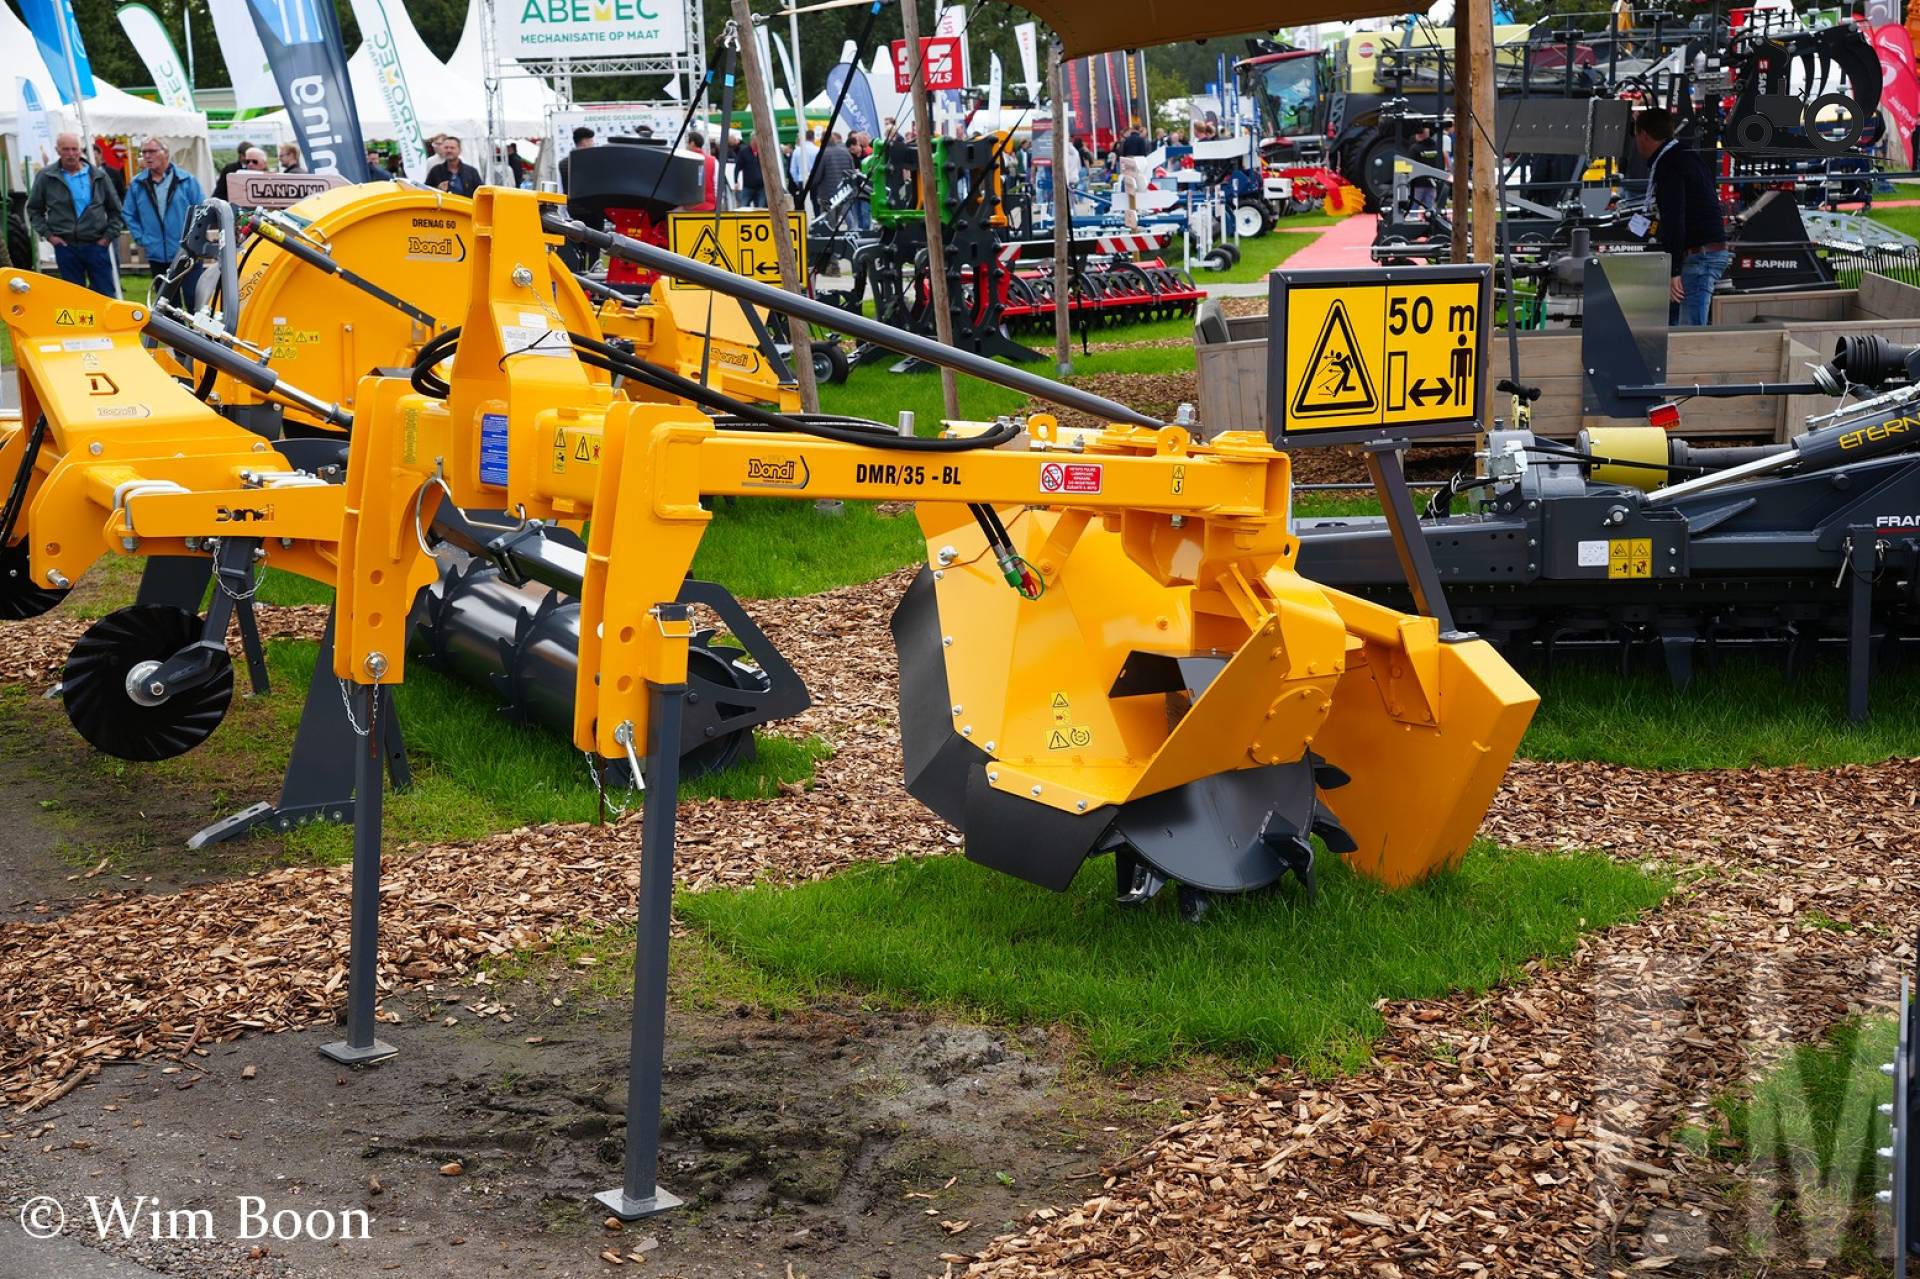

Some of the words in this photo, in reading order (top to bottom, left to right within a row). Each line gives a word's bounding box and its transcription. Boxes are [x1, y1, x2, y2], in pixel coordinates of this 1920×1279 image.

[521, 32, 605, 44] MECHANISATIE
[609, 31, 625, 41] OP
[627, 29, 660, 40] MAAT
[1758, 73, 1767, 95] SAP
[412, 218, 444, 228] DRENAG
[740, 225, 769, 242] 50
[408, 236, 453, 255] Dondi
[1608, 243, 1644, 252] SAPHIR
[1754, 260, 1798, 269] SAPHIR
[1388, 295, 1433, 336] 50
[1447, 304, 1475, 333] m
[710, 347, 749, 367] Dondi
[748, 458, 795, 480] Dondi
[856, 463, 925, 486] DMR/35
[942, 466, 962, 485] BL
